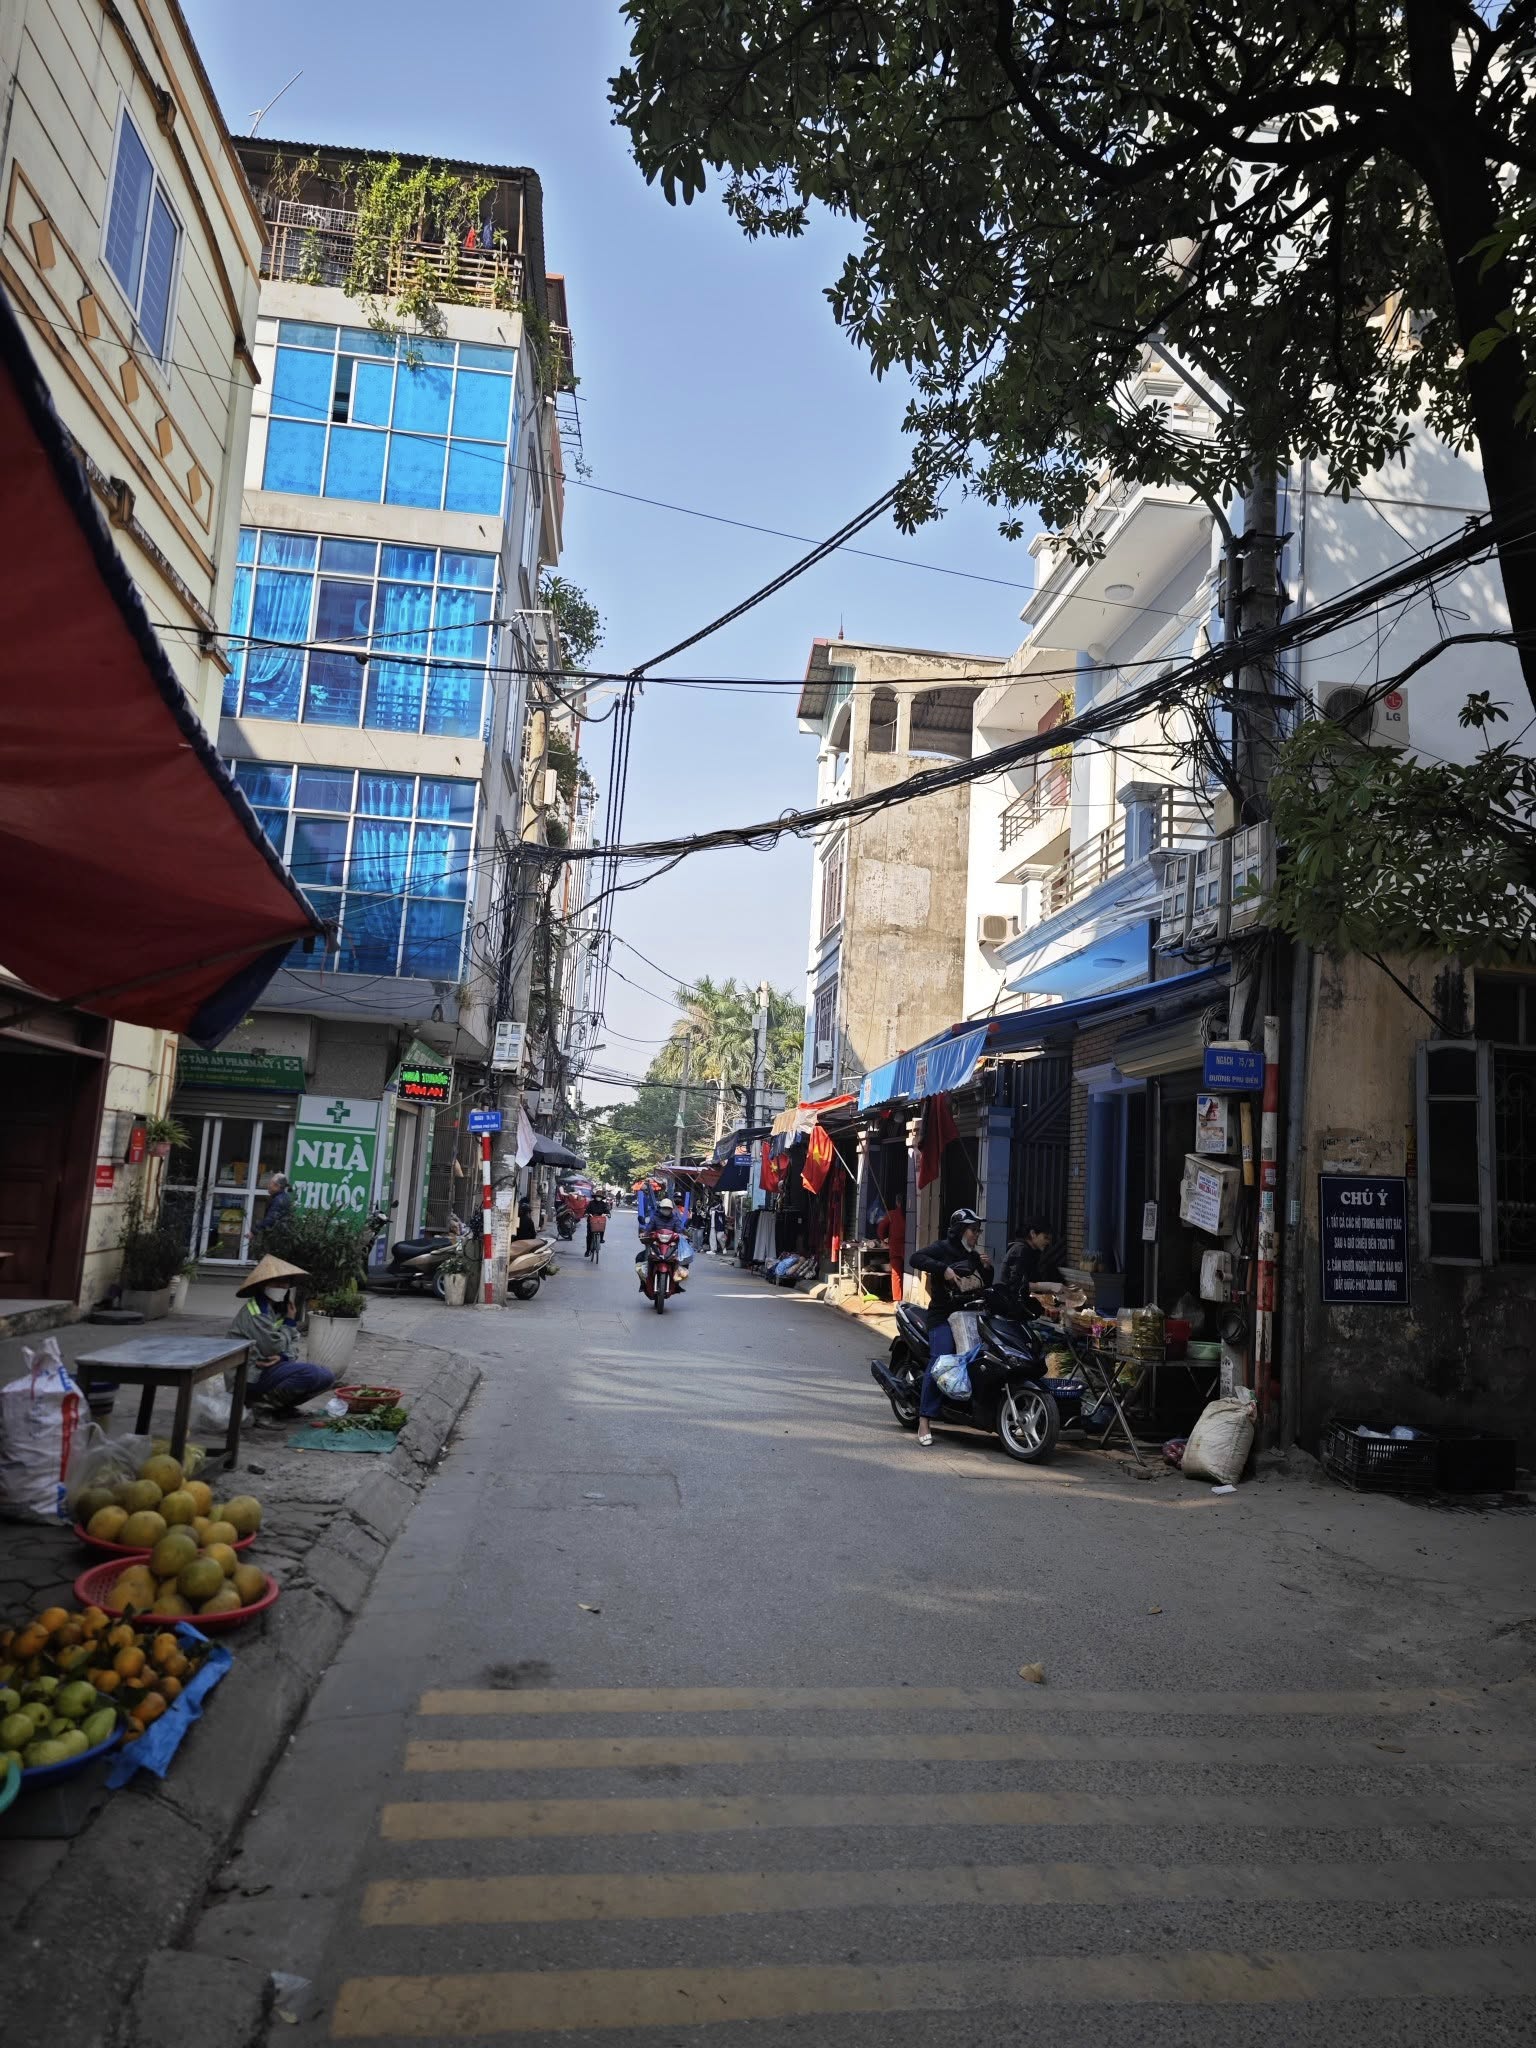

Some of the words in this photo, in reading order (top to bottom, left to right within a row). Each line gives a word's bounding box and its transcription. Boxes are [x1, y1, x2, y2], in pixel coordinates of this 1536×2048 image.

[1386, 711, 1401, 721] LG
[402, 1070, 420, 1083] NHÀ
[421, 1071, 449, 1085] THUỐC
[405, 1083, 427, 1095] TÂM
[427, 1087, 443, 1097] AN
[295, 1136, 369, 1172] NHÀ
[292, 1171, 366, 1213] THUỐC
[1340, 1188, 1374, 1206] CHÚ
[1377, 1188, 1389, 1206] Ý
